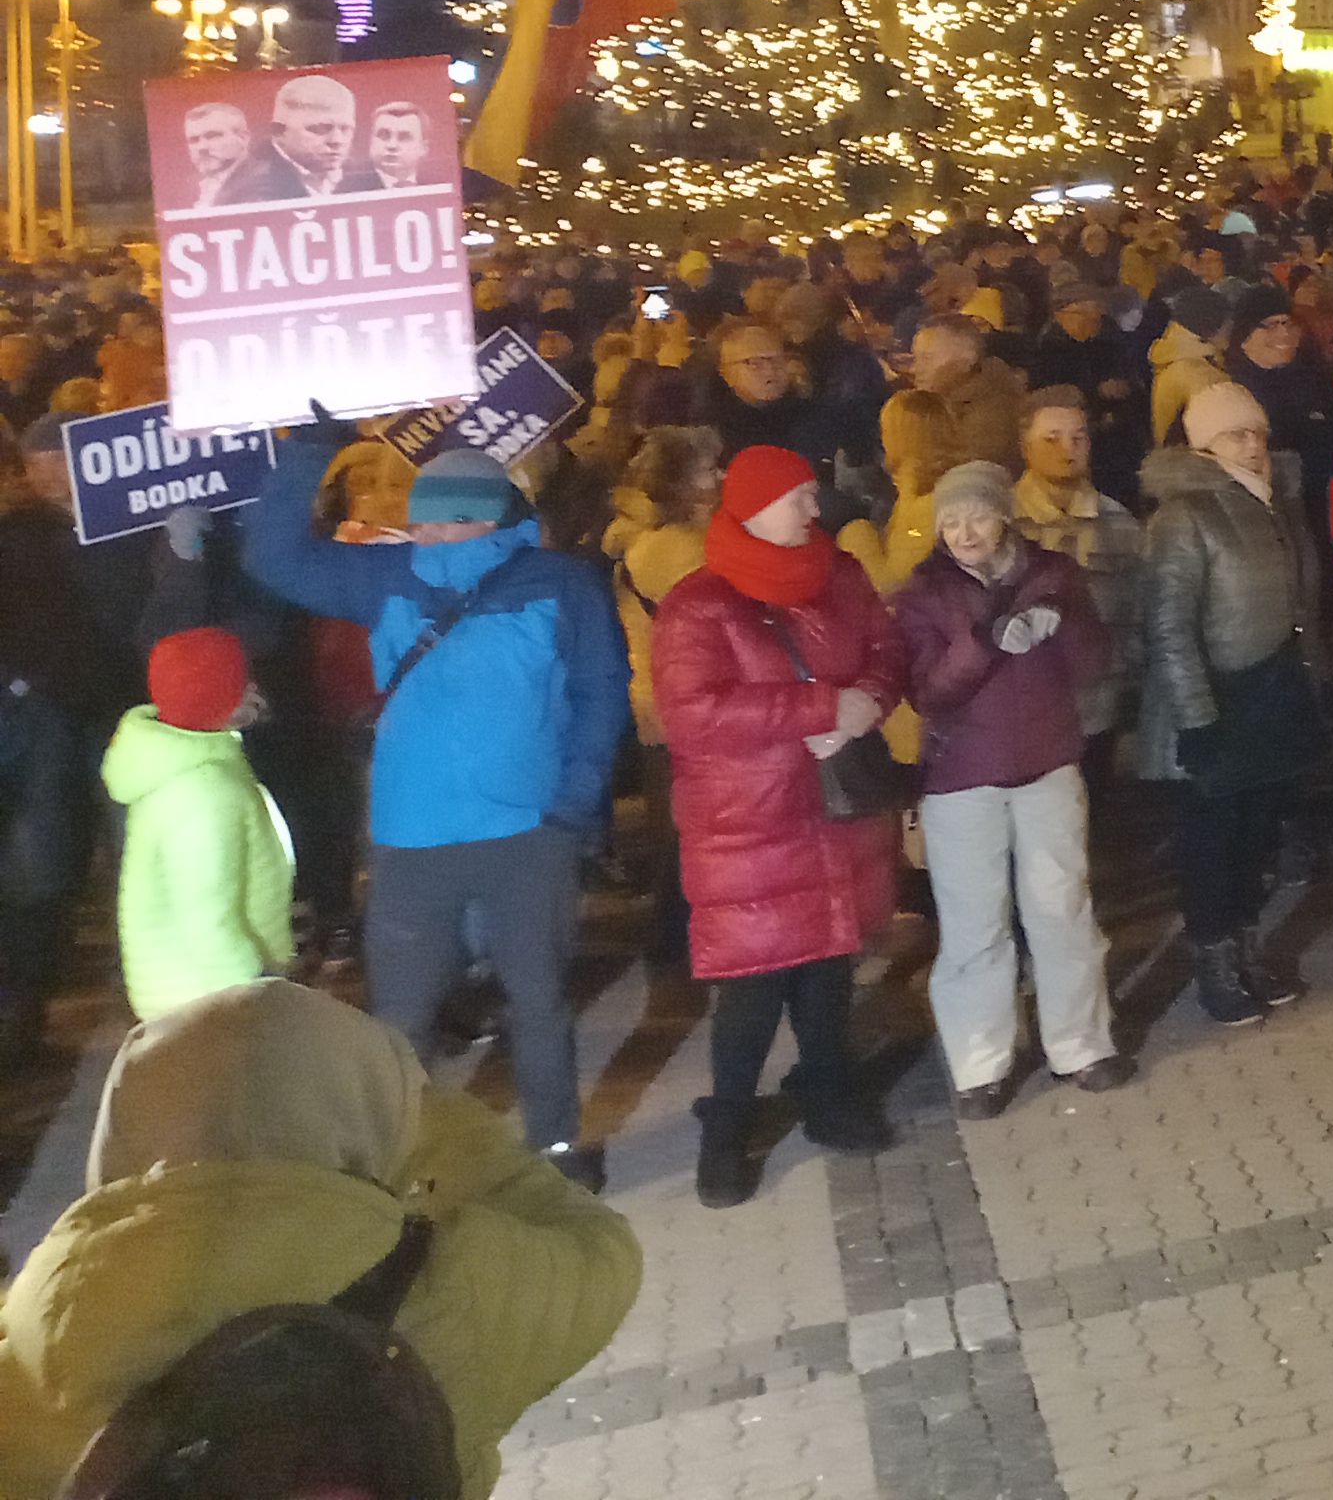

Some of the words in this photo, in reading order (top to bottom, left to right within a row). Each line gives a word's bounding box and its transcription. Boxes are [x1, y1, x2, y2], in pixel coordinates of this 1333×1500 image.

[167, 206, 459, 300] STAČILO!
[484, 413, 551, 465] ODKA
[127, 470, 230, 515] BODKA
